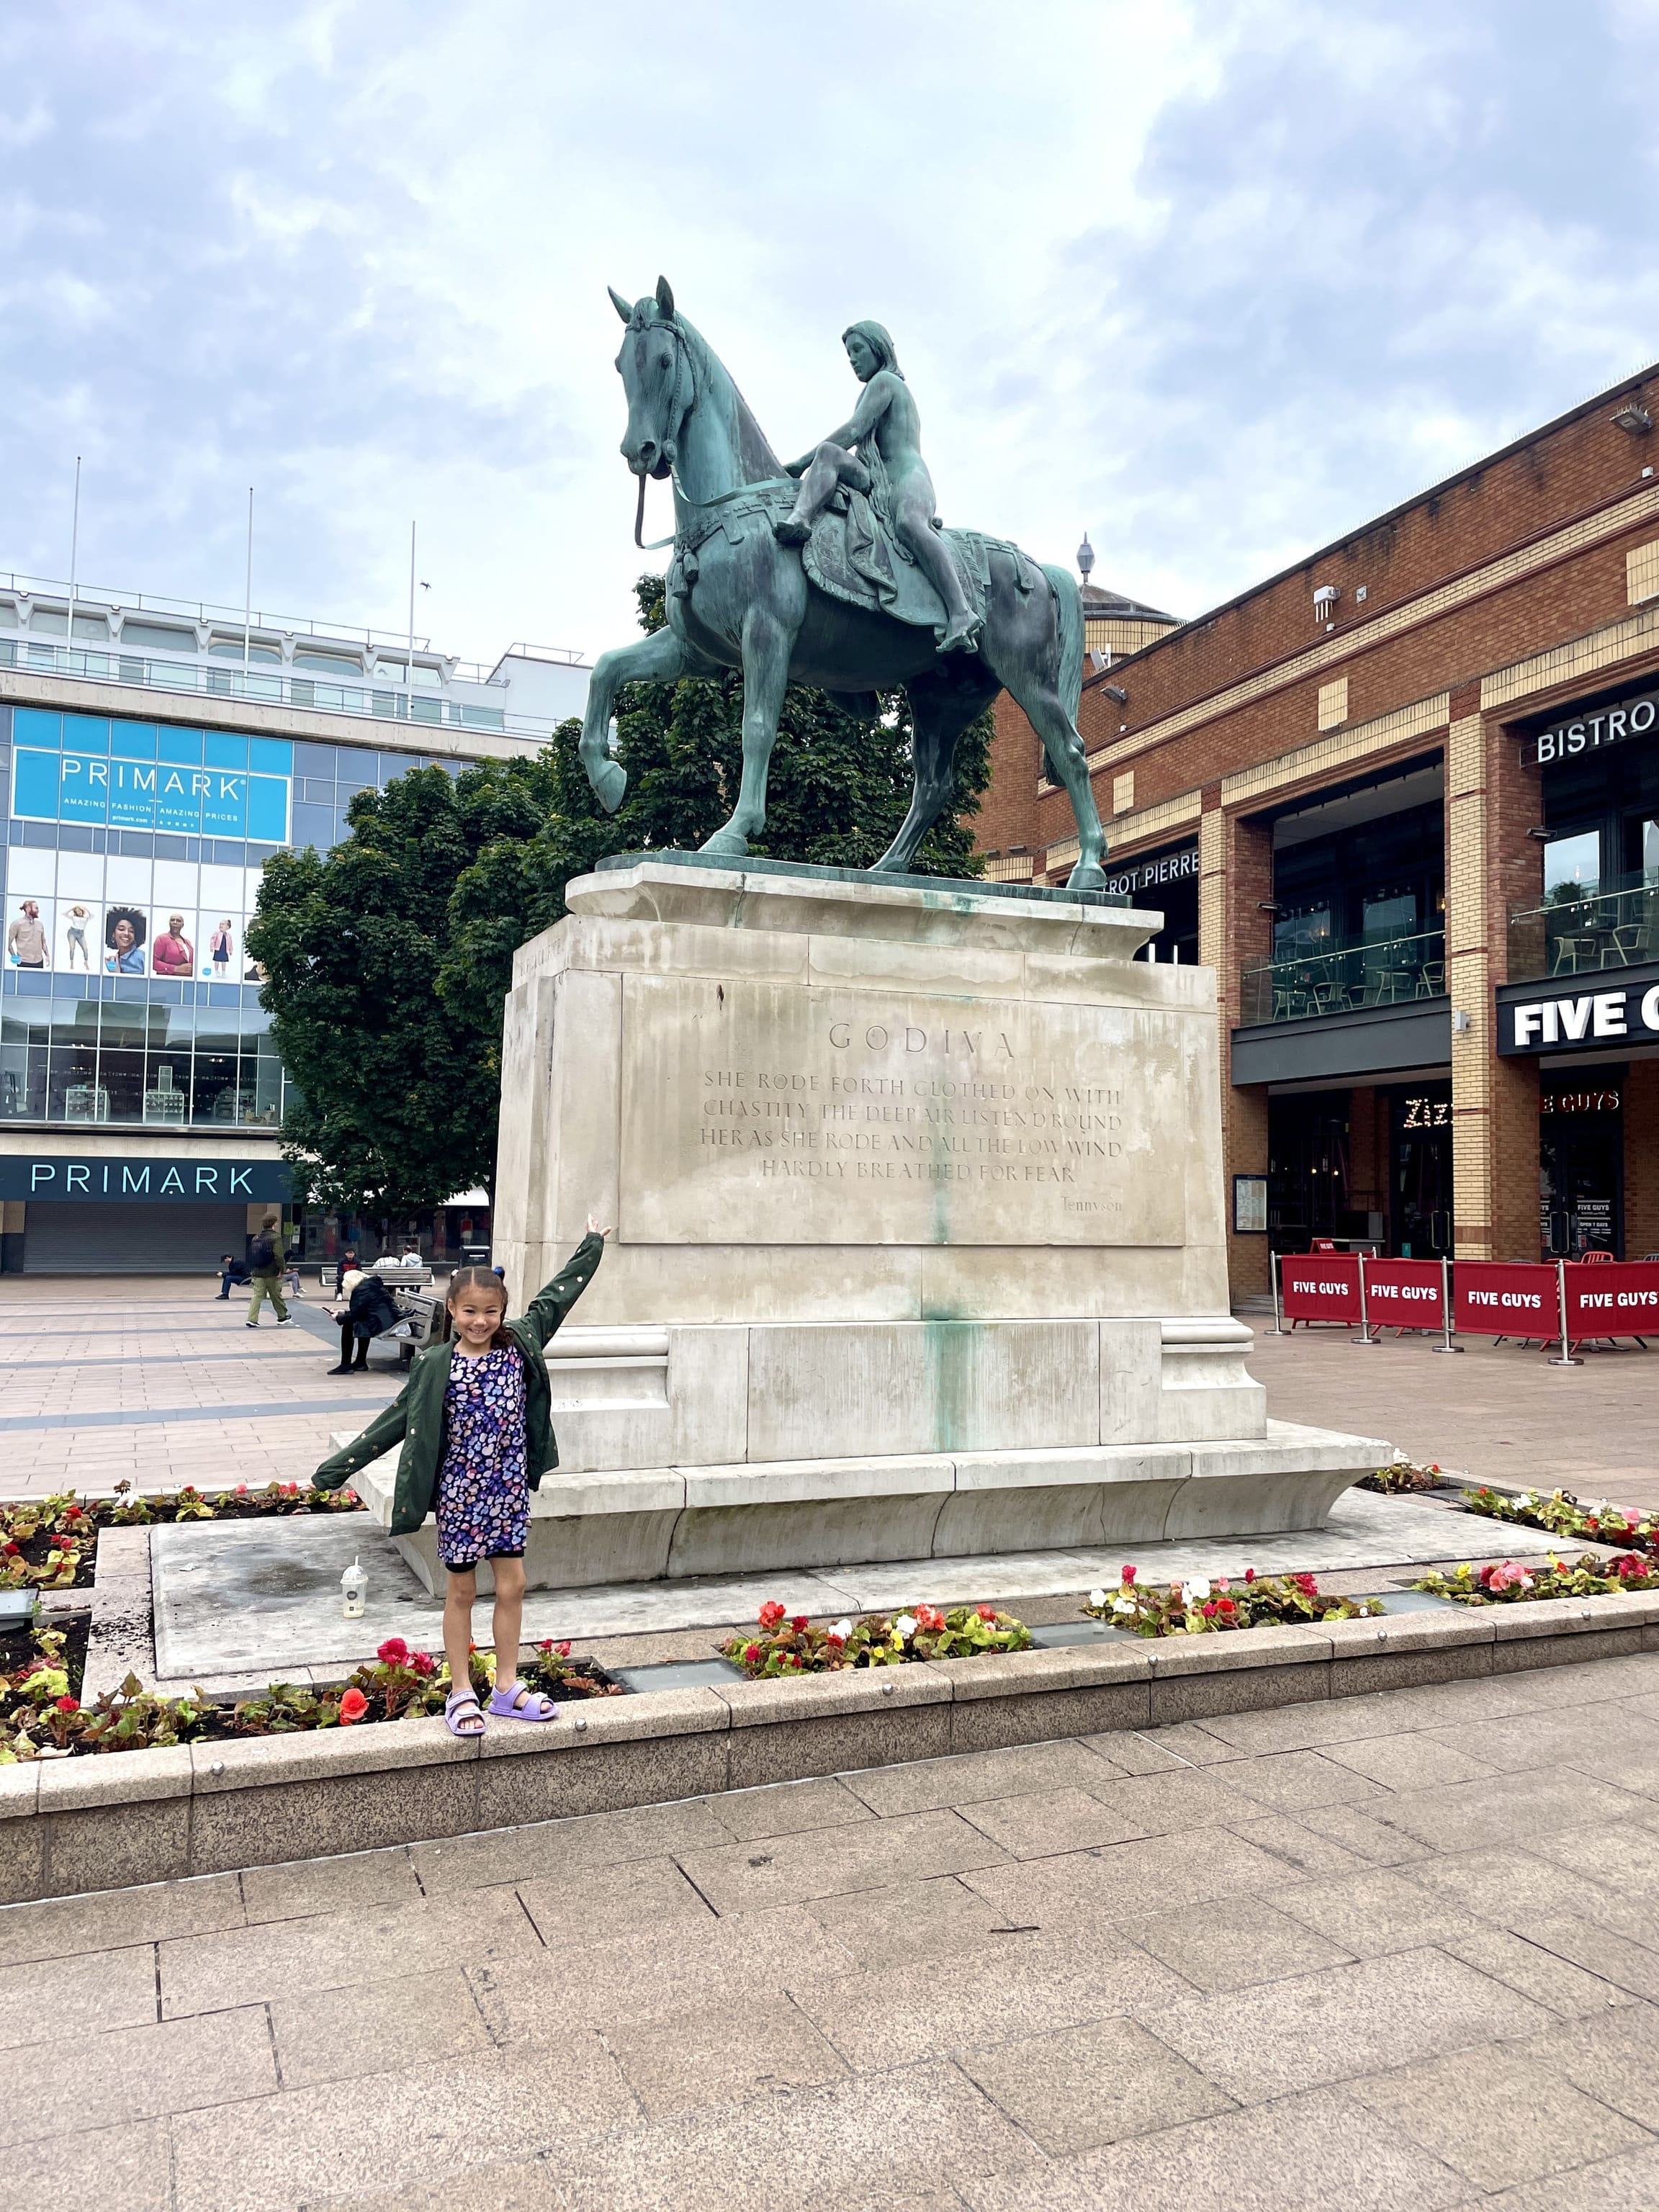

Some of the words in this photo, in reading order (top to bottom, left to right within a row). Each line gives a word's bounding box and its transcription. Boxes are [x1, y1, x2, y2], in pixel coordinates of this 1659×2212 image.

[1538, 701, 1656, 763] BISTRO
[62, 759, 240, 801] PRIMARK
[64, 798, 106, 808] AMAZING
[160, 808, 200, 817] AMAZING
[112, 815, 148, 824] primark.com
[1145, 851, 1199, 887] PIERRE
[1514, 992, 1627, 1046] FIVE
[830, 1022, 1014, 1058] GODIVA
[704, 1070, 746, 1088] SHE
[758, 1073, 820, 1091] RODE
[831, 1076, 904, 1095] FORTH
[914, 1081, 1015, 1101] CLOTHED
[1025, 1086, 1056, 1102] ON
[1066, 1088, 1120, 1105] WITH
[1557, 1090, 1619, 1112] GUYS
[703, 1100, 809, 1118] CHASTITY
[819, 1104, 858, 1120] THE
[866, 1105, 917, 1123] DEEP
[922, 1108, 955, 1125] AIR
[1052, 1113, 1122, 1132] ROUND
[701, 1128, 744, 1146] HER
[748, 1130, 773, 1147] AS
[781, 1130, 818, 1148] SHE
[826, 1133, 882, 1150] RODE
[888, 1135, 932, 1152] AND
[938, 1136, 969, 1153] ALL
[976, 1137, 1011, 1154] THE
[1020, 1139, 1062, 1155] LOW
[1067, 1140, 1122, 1157] WIND
[30, 1164, 253, 1195] PRIMARK
[763, 1160, 848, 1178] HARDLY
[857, 1162, 971, 1181] BREATHED
[979, 1165, 1019, 1182] FOR
[1025, 1166, 1075, 1182] FEAR
[1293, 1281, 1316, 1294] FIVE
[1319, 1282, 1349, 1295] GUYS
[1371, 1285, 1398, 1298] FIVE
[1401, 1287, 1438, 1301] GUYS
[1468, 1291, 1498, 1306] FIVE
[1501, 1292, 1542, 1308] GUYS
[1580, 1293, 1613, 1308] FIVE
[1617, 1291, 1658, 1306] GUYS
